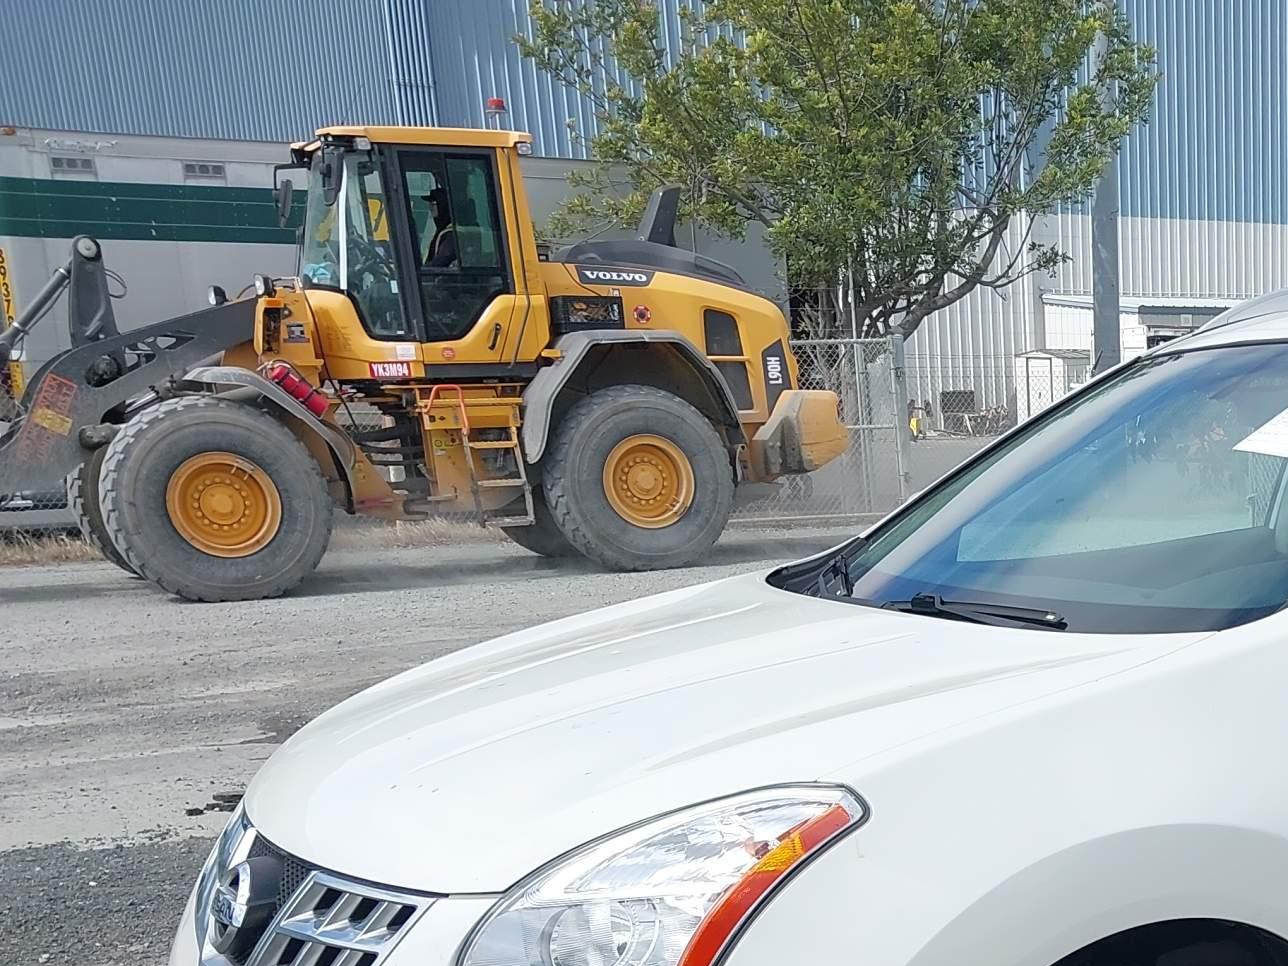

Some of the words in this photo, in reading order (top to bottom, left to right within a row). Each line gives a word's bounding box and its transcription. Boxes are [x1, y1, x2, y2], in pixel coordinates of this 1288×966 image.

[581, 270, 647, 282] VOLVO
[371, 362, 409, 377] YK3M94
[766, 356, 783, 385] L90H
